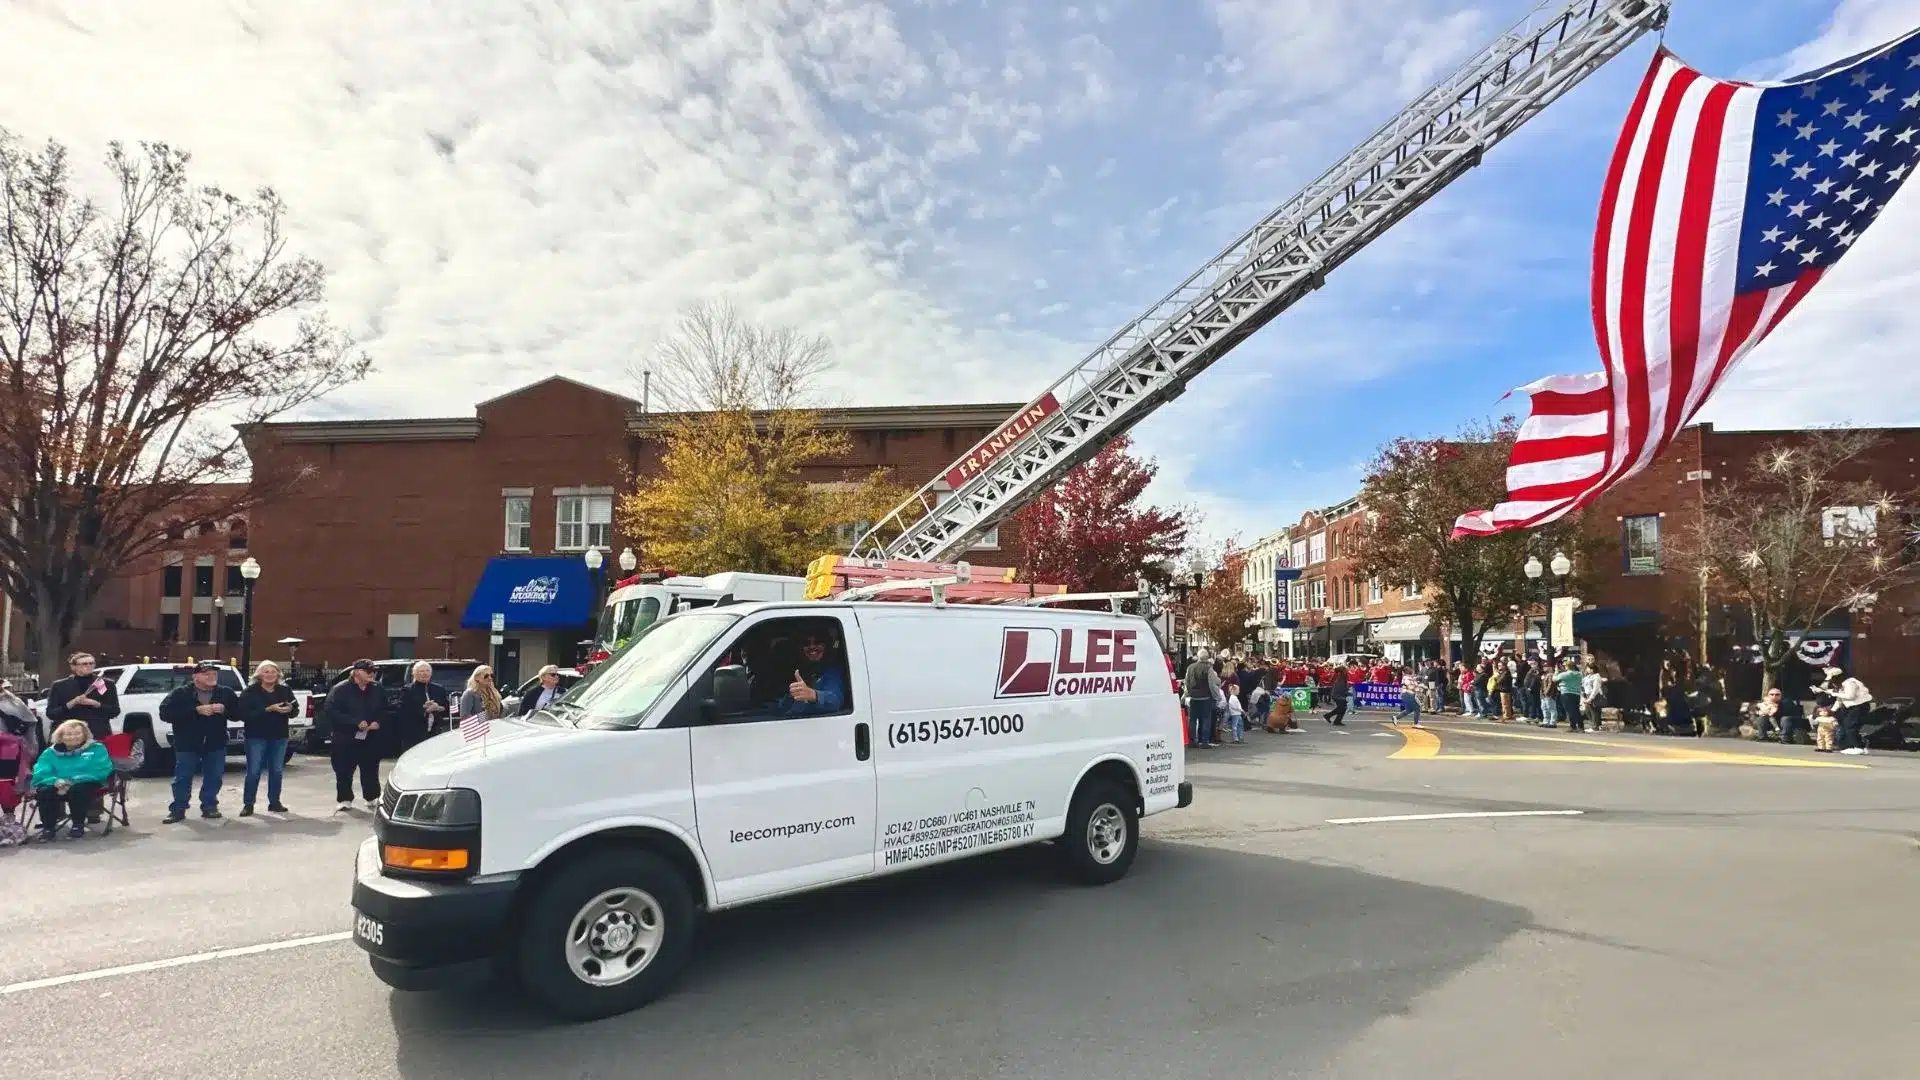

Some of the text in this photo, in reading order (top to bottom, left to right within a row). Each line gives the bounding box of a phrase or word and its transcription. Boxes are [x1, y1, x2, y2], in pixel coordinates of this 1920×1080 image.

[959, 405, 1045, 478] FRANKLIN
[1057, 629, 1137, 674] LEE
[1054, 676, 1136, 696] COMPANY
[1357, 691, 1385, 700] MIDDLE
[888, 713, 1024, 748] (615)567-1000
[1150, 740, 1165, 749] HVAC
[1150, 752, 1173, 761] Plumbing
[1150, 763, 1172, 773] Electrical
[1150, 775, 1169, 784] Building
[885, 821, 913, 836] JC142
[919, 815, 947, 830] DC660
[953, 809, 978, 823] VC461
[980, 802, 1022, 818] NASHVILLE
[1025, 800, 1035, 810] TN
[1025, 812, 1034, 821] AL
[729, 816, 855, 843] leecompany.com
[885, 823, 1035, 866] HM#04556/MP#5207/ME#65780 KY
